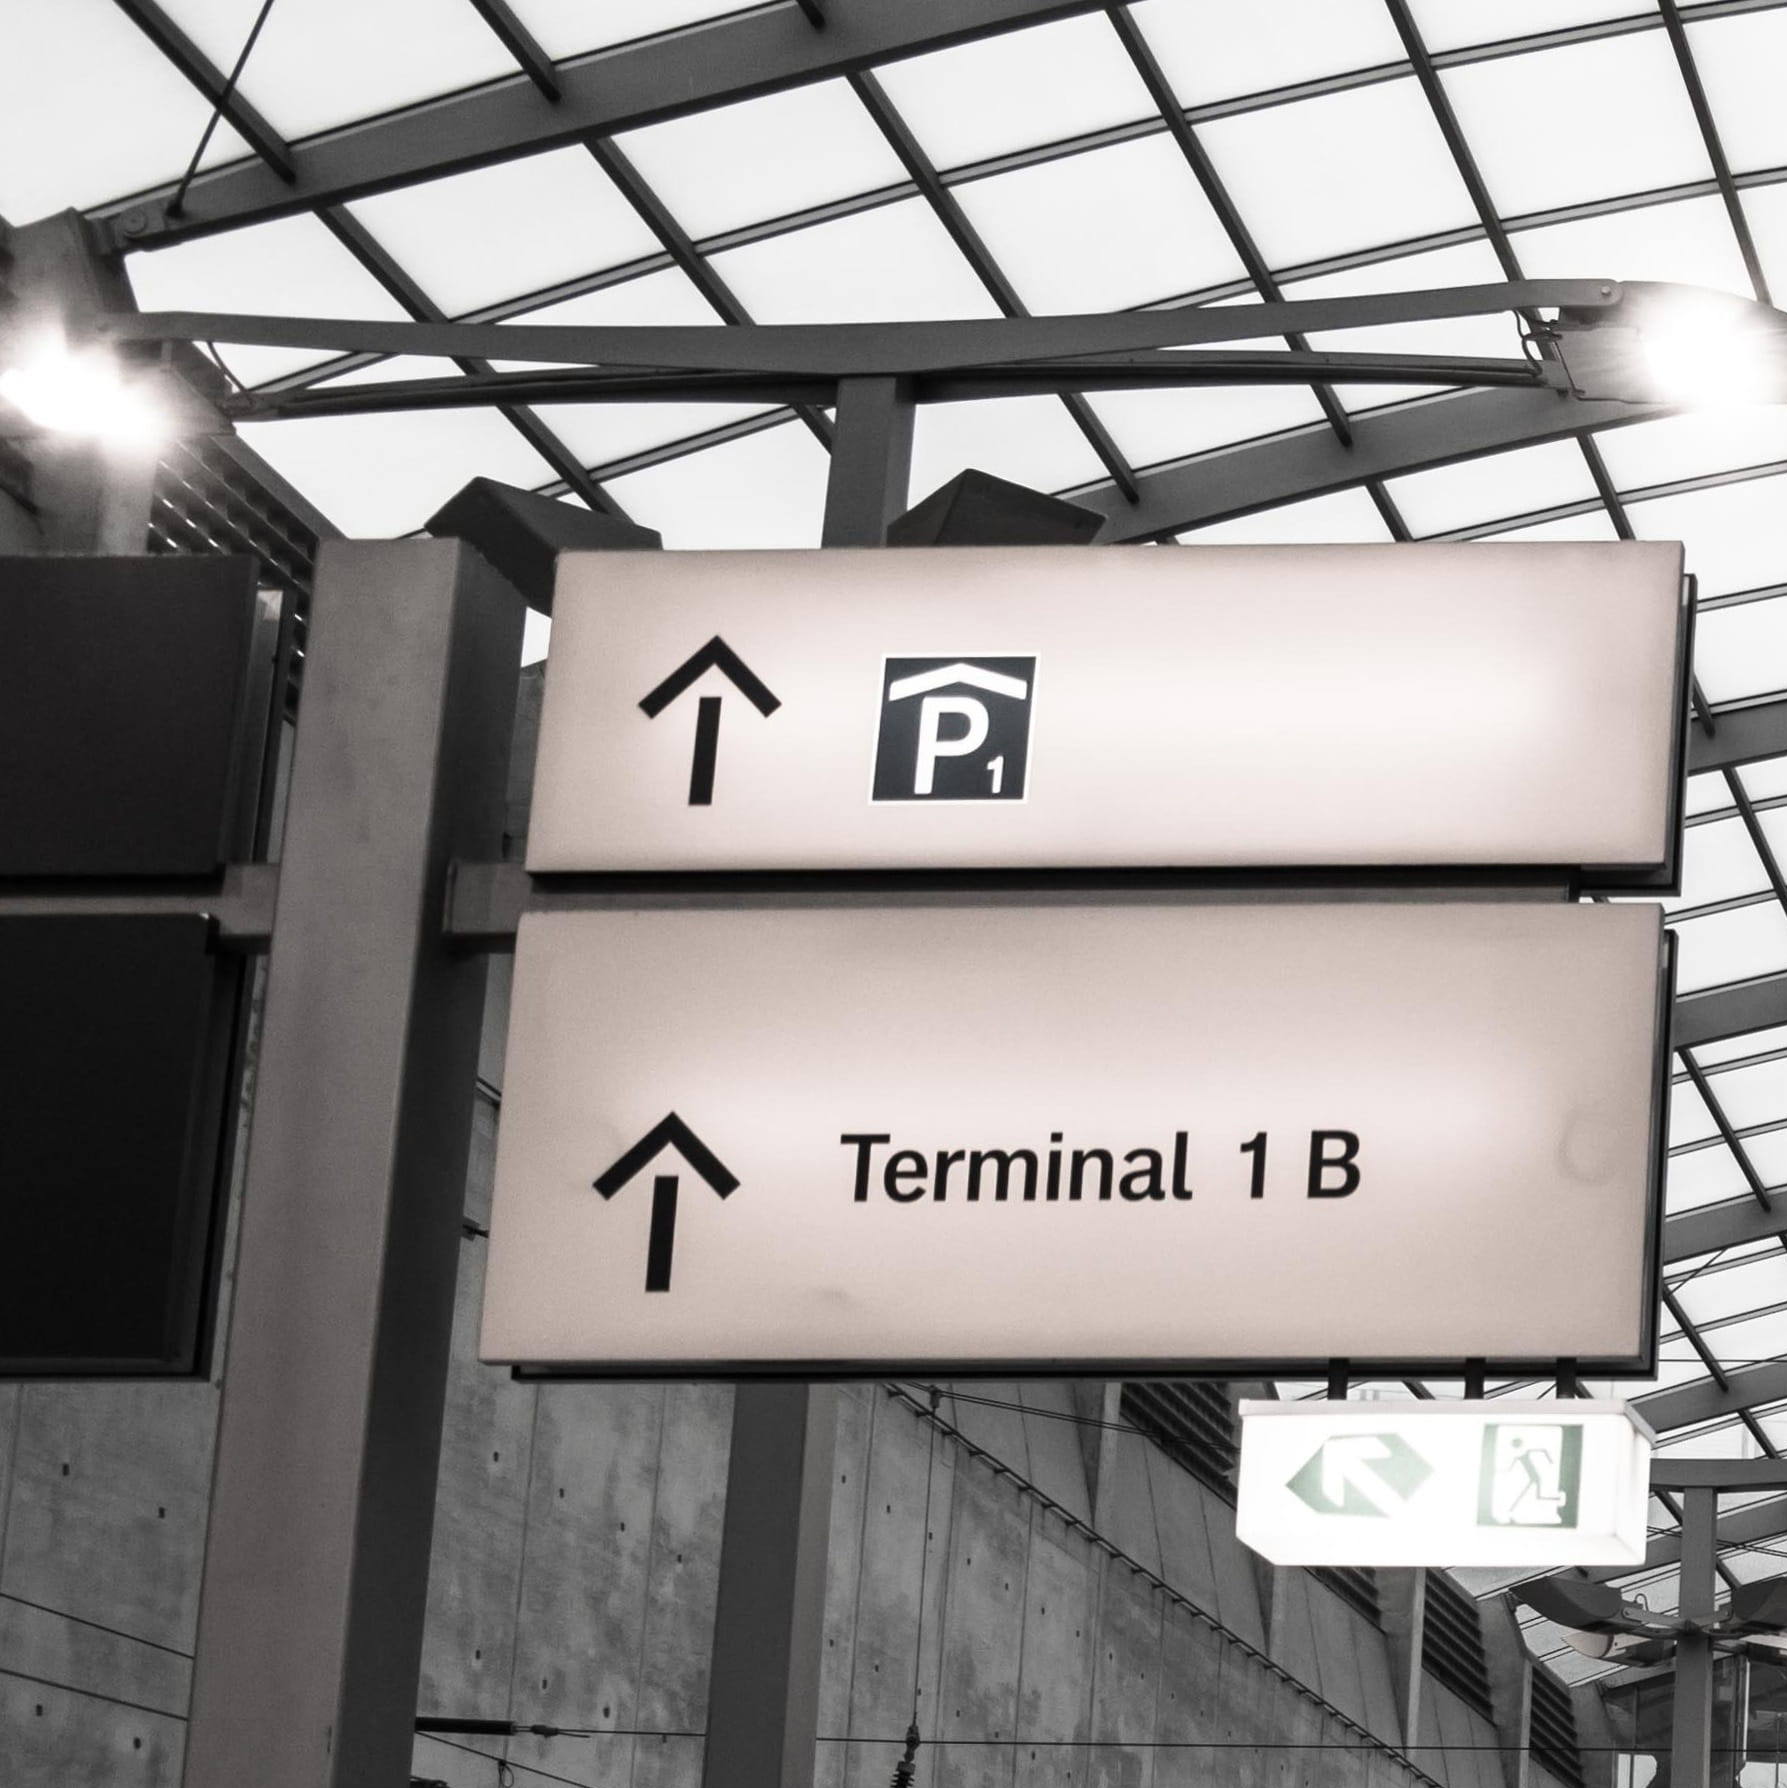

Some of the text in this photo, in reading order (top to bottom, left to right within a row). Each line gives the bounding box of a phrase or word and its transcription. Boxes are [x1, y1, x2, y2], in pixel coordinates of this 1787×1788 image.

[840, 1130, 1361, 1203] Terminal 1 B
